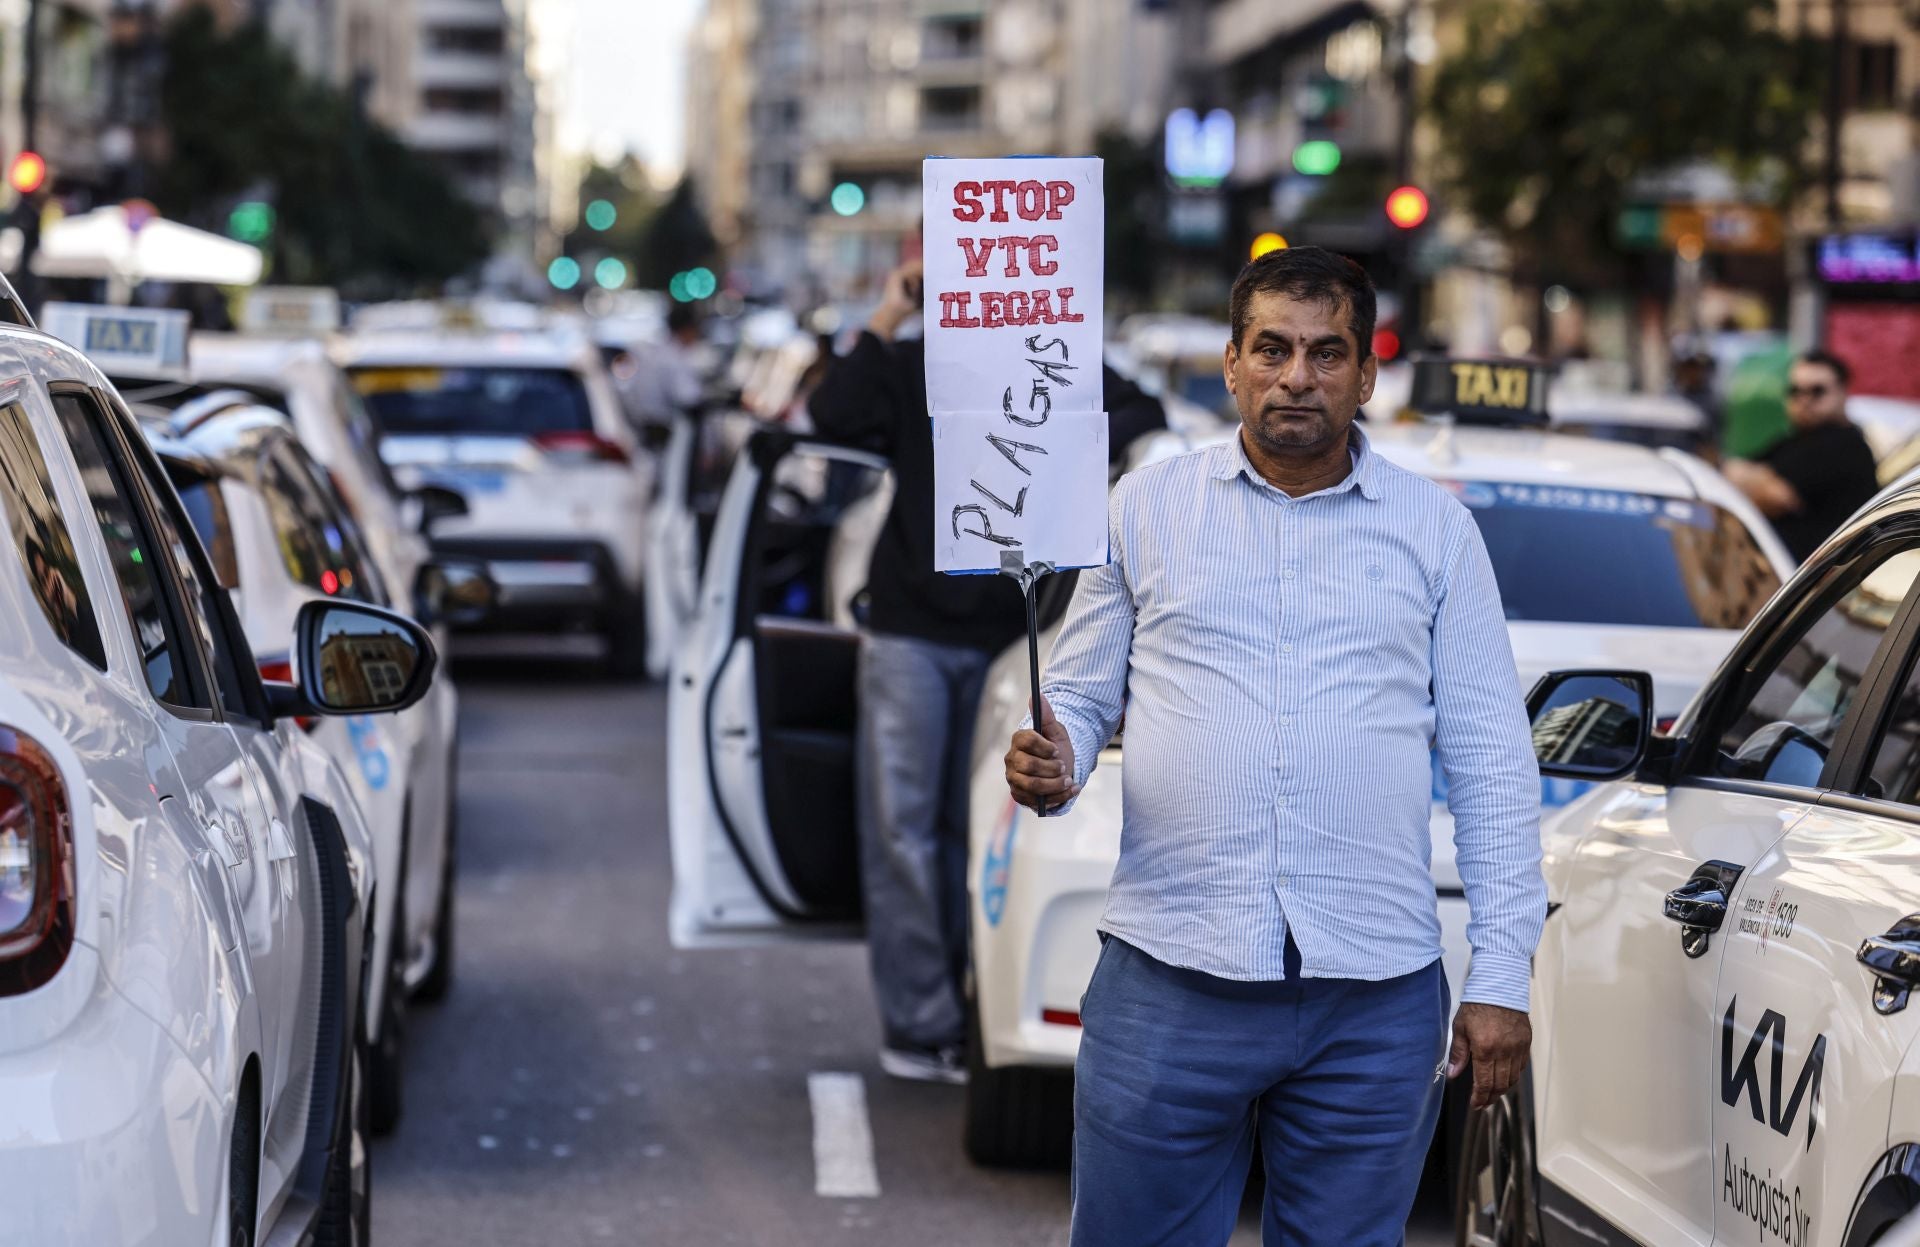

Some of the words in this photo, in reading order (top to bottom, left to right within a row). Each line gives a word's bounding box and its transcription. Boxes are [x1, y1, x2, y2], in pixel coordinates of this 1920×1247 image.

[953, 180, 1075, 222] STOP
[957, 235, 1058, 277] VTC
[939, 287, 1084, 328] ILEGAL
[90, 317, 156, 351] TAXI
[1451, 362, 1528, 409] TAXI
[952, 334, 1079, 547] PLAGAS
[1773, 902, 1798, 938] 1508
[1723, 1143, 1791, 1246] Autopista
[1794, 1185, 1810, 1247] Sur
